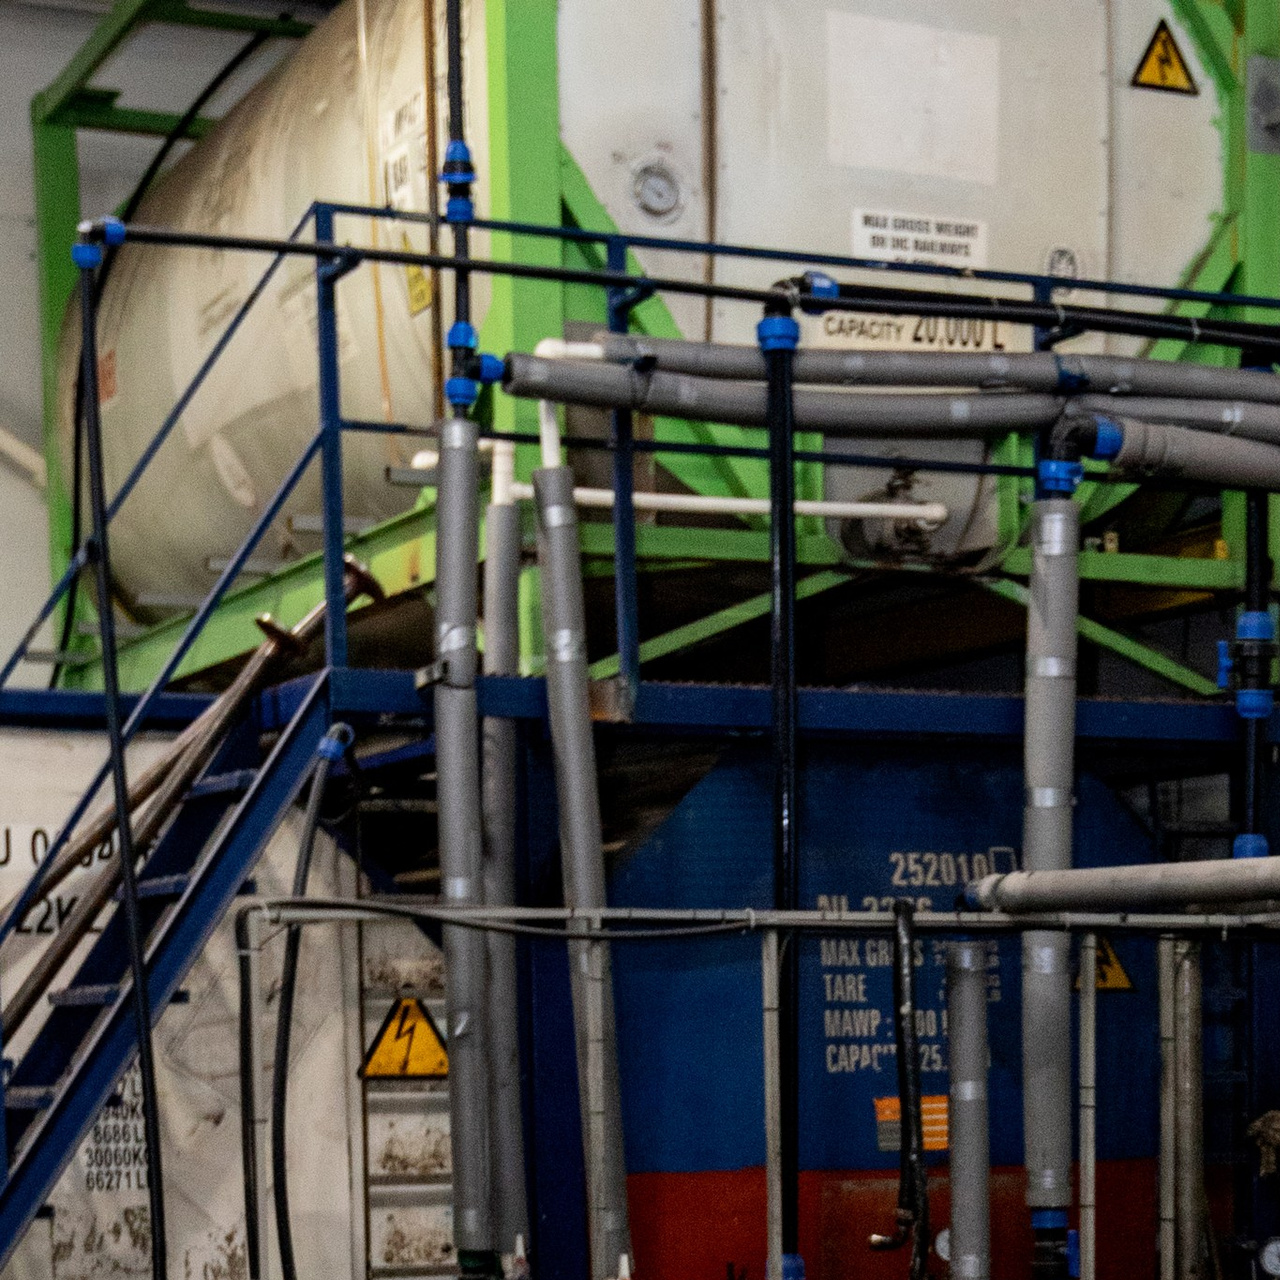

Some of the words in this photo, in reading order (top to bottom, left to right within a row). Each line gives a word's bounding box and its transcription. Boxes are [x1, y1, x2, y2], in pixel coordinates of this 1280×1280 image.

[824, 315, 904, 341] CAPACITY
[889, 852, 988, 887] 252010
[820, 939, 861, 967] MAX
[865, 939, 925, 967] GRS
[823, 973, 868, 1003] TARE
[824, 1009, 882, 1038] MAWP
